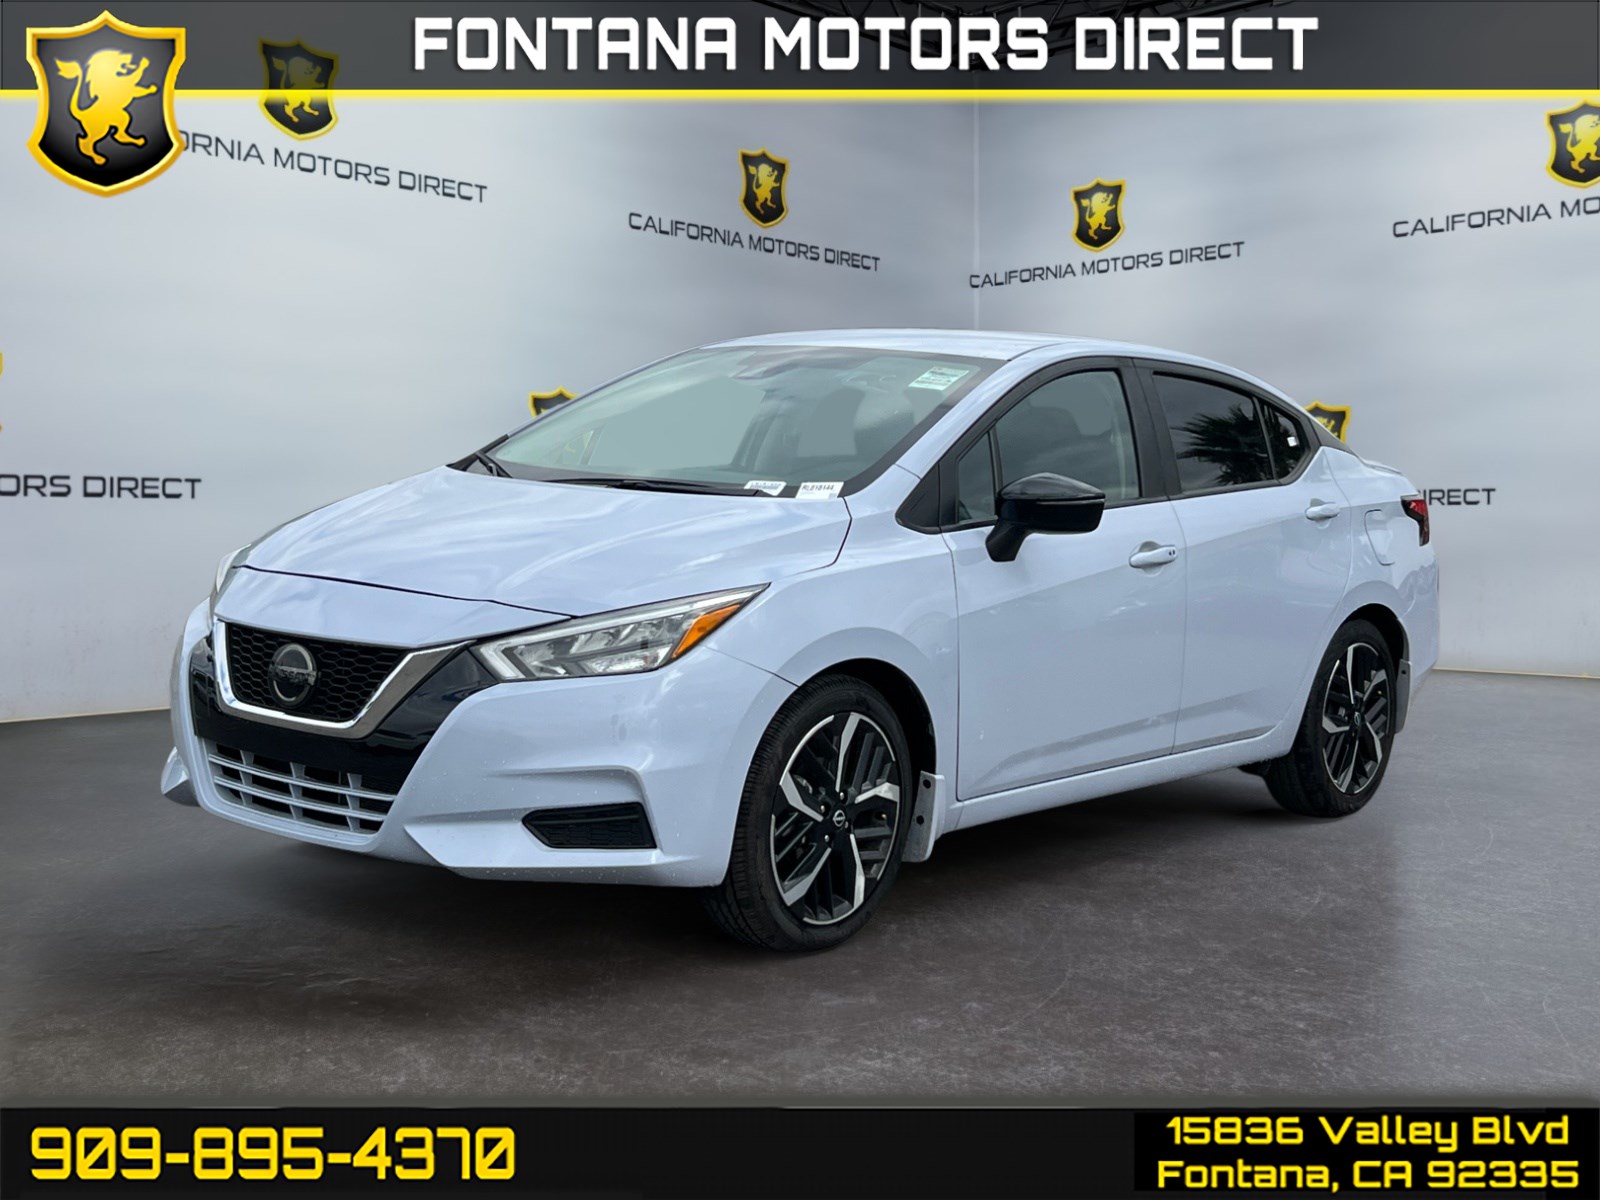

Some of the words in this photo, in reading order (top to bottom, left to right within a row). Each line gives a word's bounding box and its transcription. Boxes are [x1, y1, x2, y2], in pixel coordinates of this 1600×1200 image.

[272, 147, 390, 187] MOTORS
[398, 170, 488, 203] DIRECT
[628, 212, 744, 249] CALIFORNIA
[748, 233, 820, 261] MOTORS
[824, 247, 881, 272] DIRECT
[1392, 203, 1553, 239] CALIFORNIA
[969, 263, 1077, 289] CALIFORNIA
[1081, 251, 1164, 277] MOTORS
[1169, 241, 1246, 266] DIRECT
[0, 473, 72, 498] ORS
[83, 475, 203, 500] DIRECT
[1418, 487, 1497, 506] IRECT
